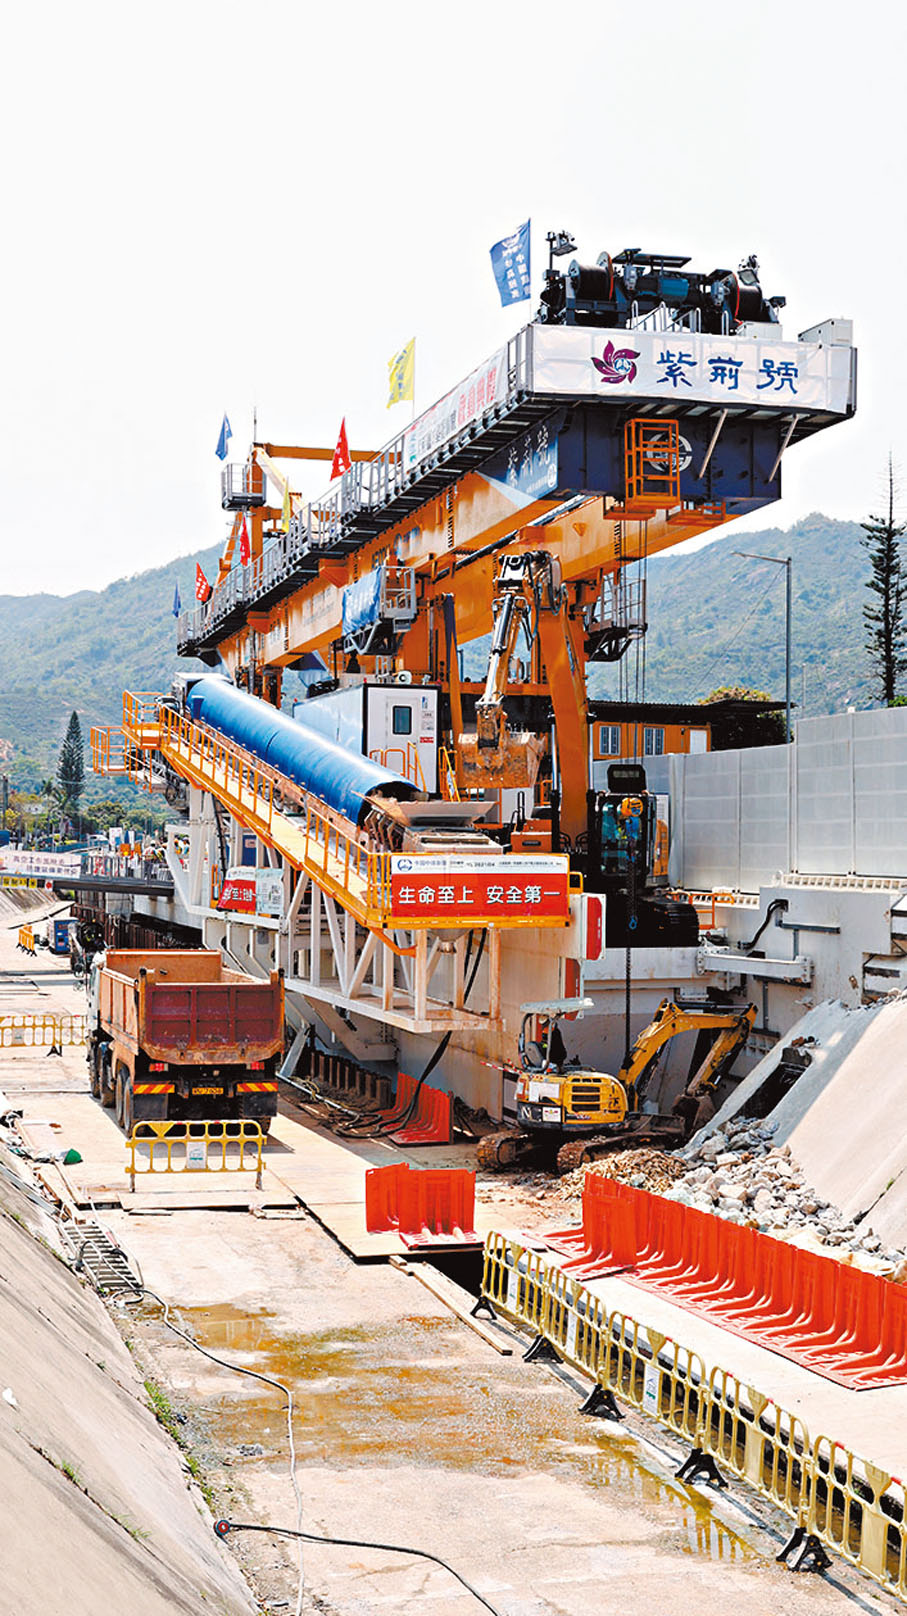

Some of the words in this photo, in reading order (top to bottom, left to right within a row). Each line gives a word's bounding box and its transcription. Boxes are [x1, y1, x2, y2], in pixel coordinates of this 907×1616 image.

[656, 349, 799, 394] 紫荊號
[398, 885, 475, 904] 生命至上
[486, 885, 561, 904] 安全第一
